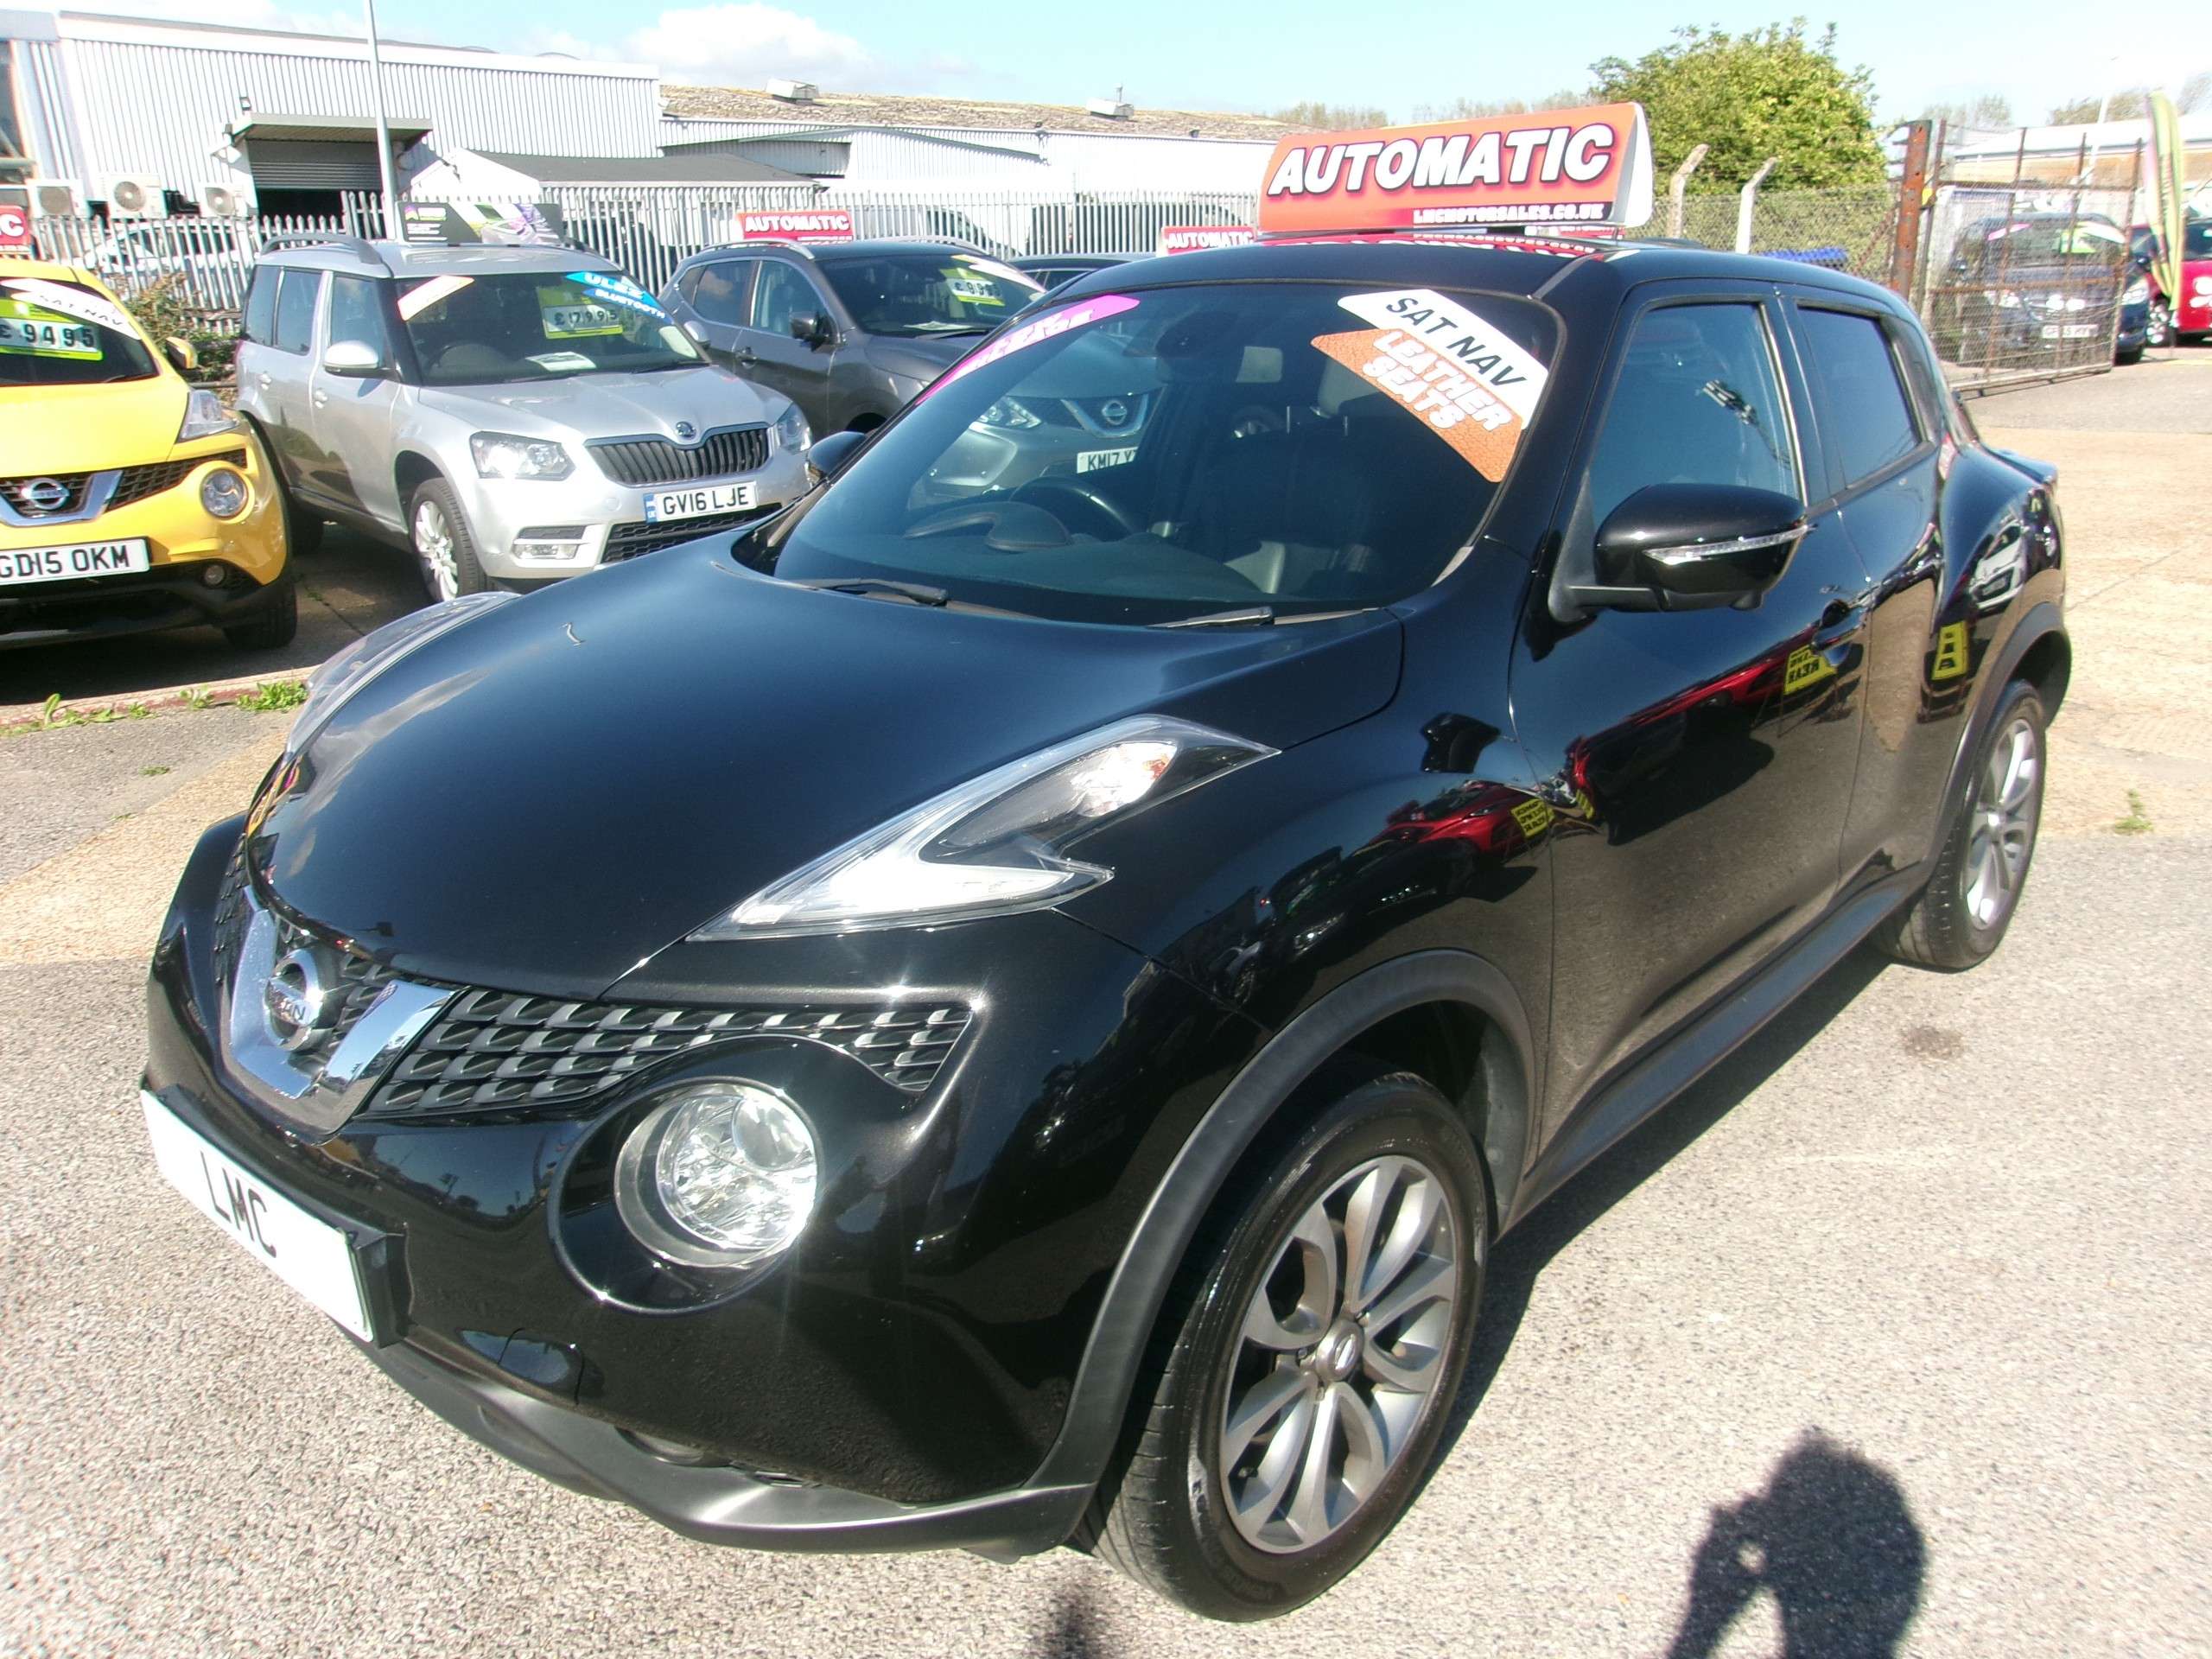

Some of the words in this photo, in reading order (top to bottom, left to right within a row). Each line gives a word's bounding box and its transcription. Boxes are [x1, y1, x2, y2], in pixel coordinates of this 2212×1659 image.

[1267, 123, 1615, 197] AUTOMATIC
[0, 213, 24, 238] C
[745, 213, 851, 233] AUTOMATIC
[1168, 231, 1254, 248] AUTOMATIC
[1386, 297, 1459, 334] SAT
[1446, 334, 1527, 387] NAV
[1362, 354, 1466, 429] SEATS
[1372, 330, 1513, 432] LEATHER
[663, 492, 707, 516] GV16
[712, 486, 749, 509] LJE
[0, 550, 63, 579] GD15
[72, 544, 130, 572] OKM
[200, 1150, 277, 1260] LMC
